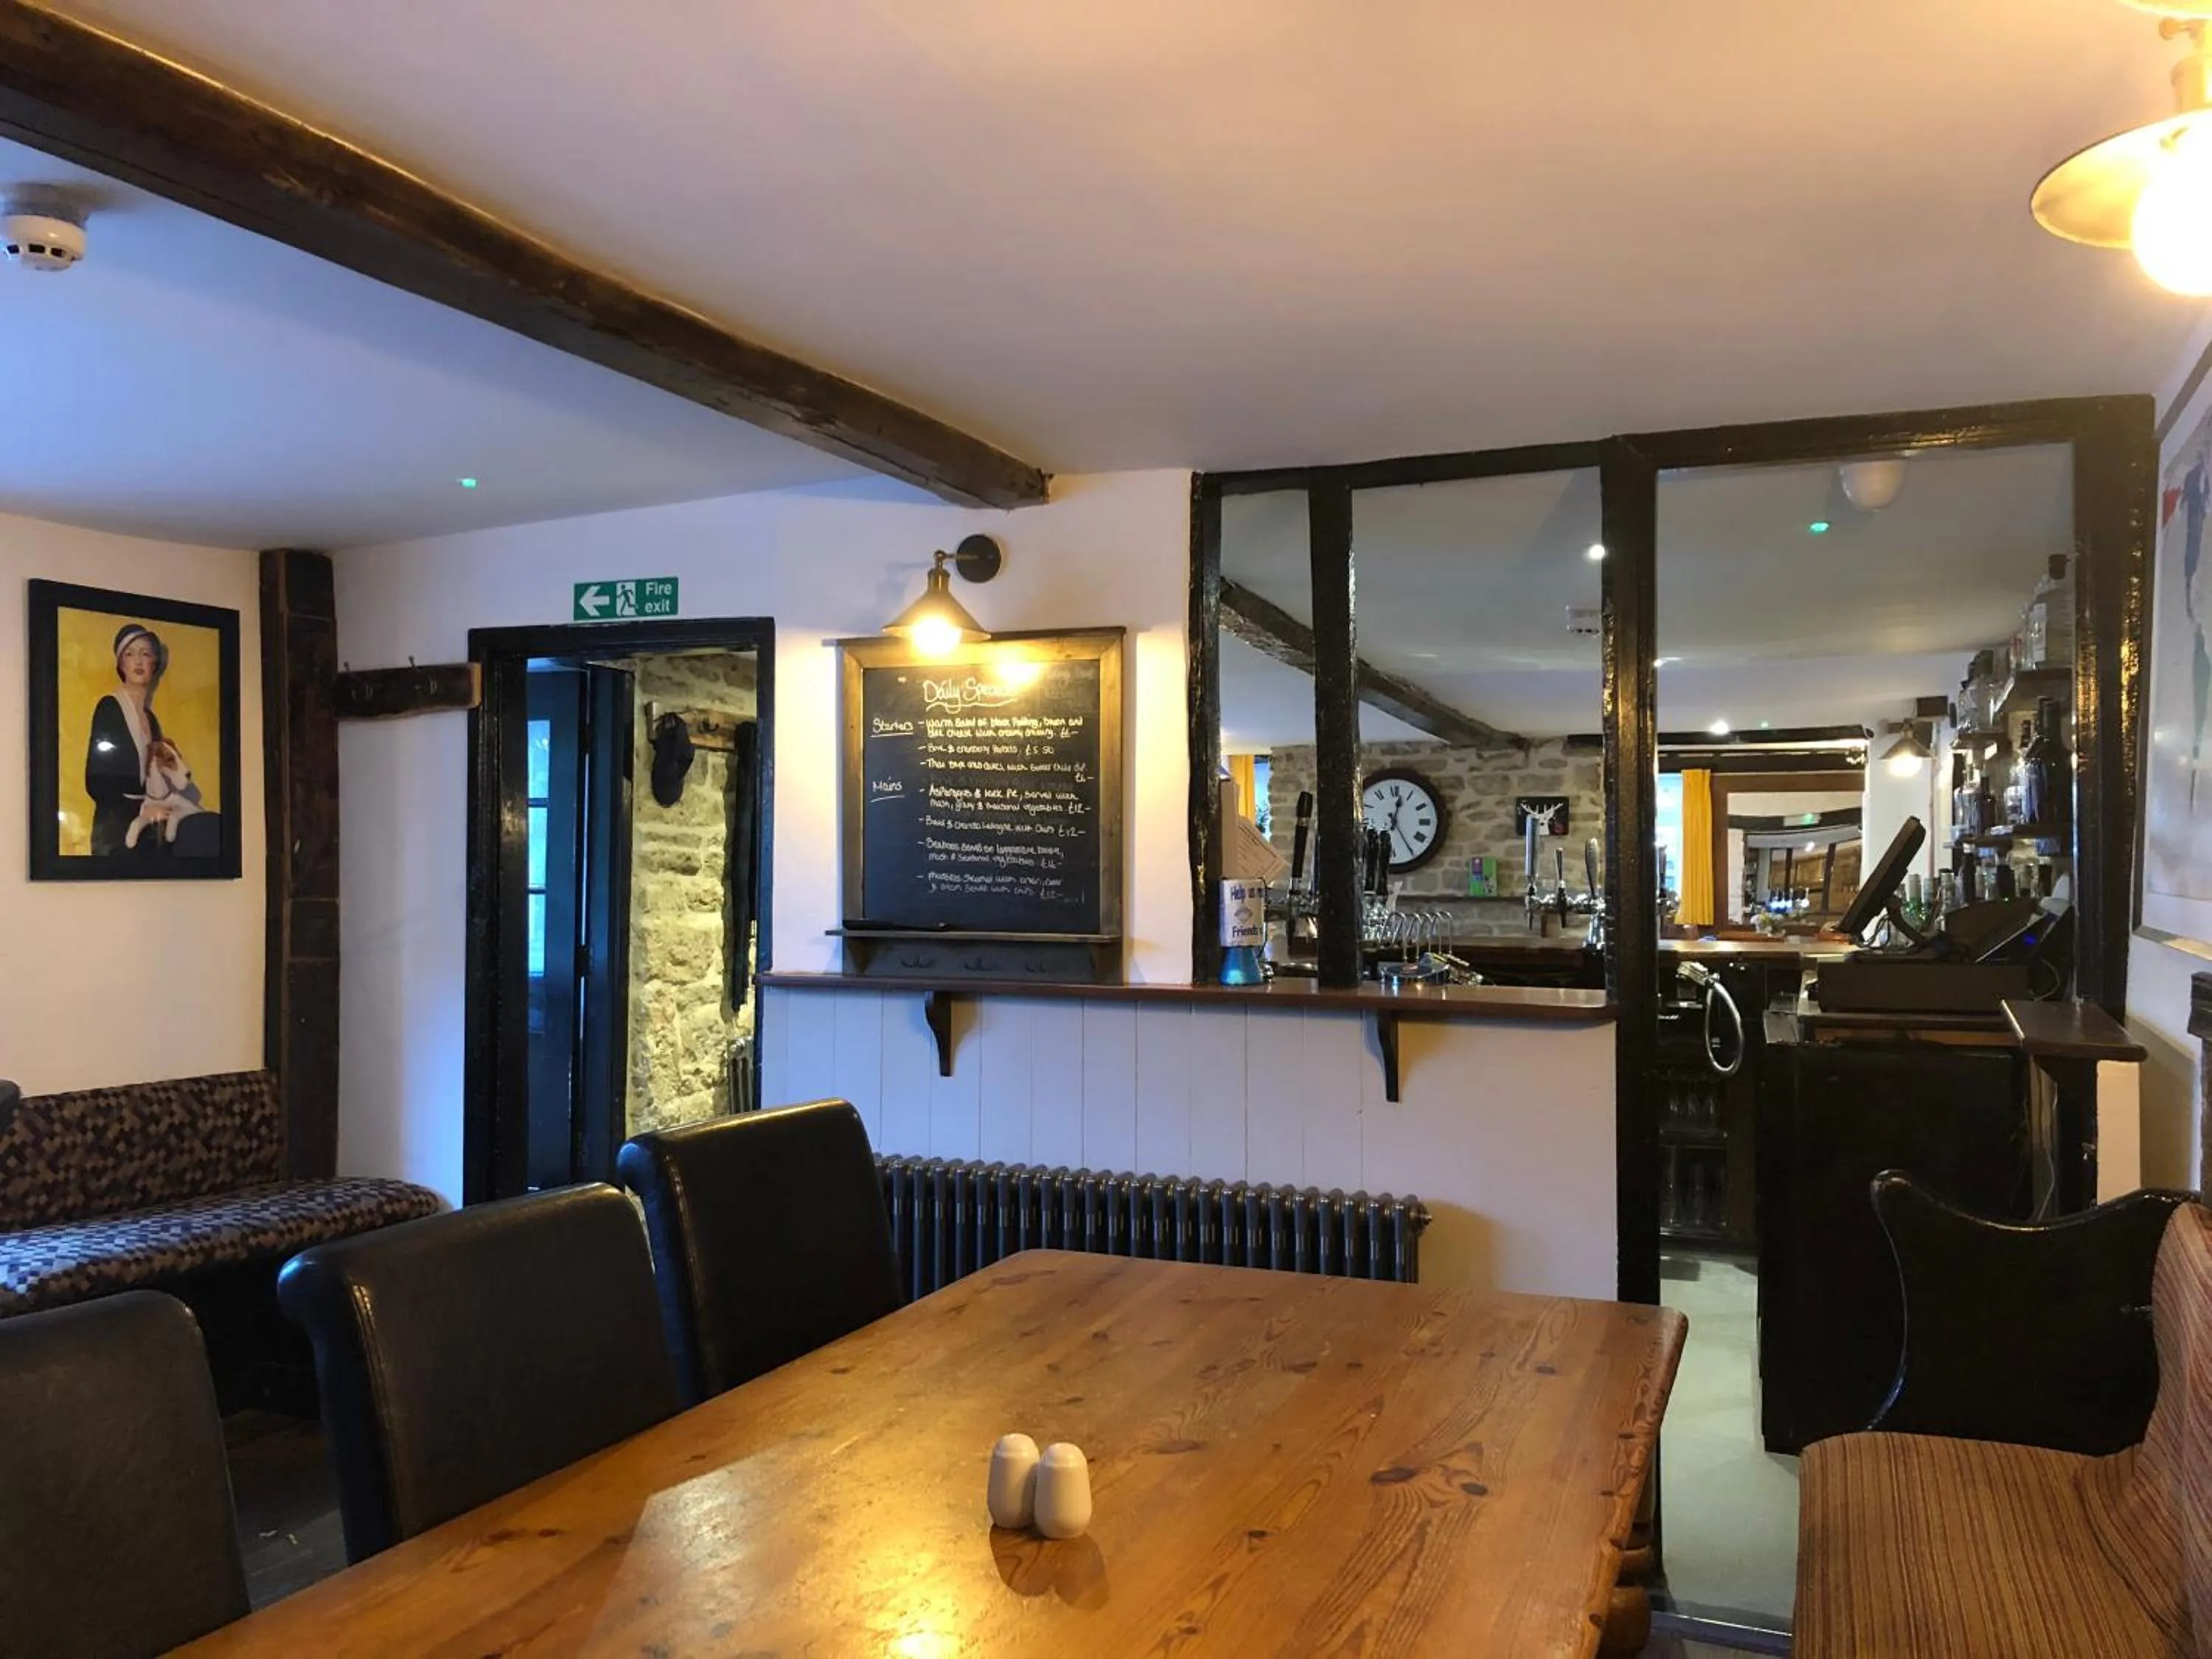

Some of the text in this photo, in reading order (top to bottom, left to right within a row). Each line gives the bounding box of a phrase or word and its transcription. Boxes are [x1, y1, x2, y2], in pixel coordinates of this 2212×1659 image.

[646, 582, 672, 595] Fire
[645, 599, 670, 613] exit
[923, 678, 961, 714] Daily
[872, 717, 914, 733] Starters
[1068, 716, 1083, 726] and
[872, 776, 902, 793] Mains
[1231, 885, 1246, 903] Help
